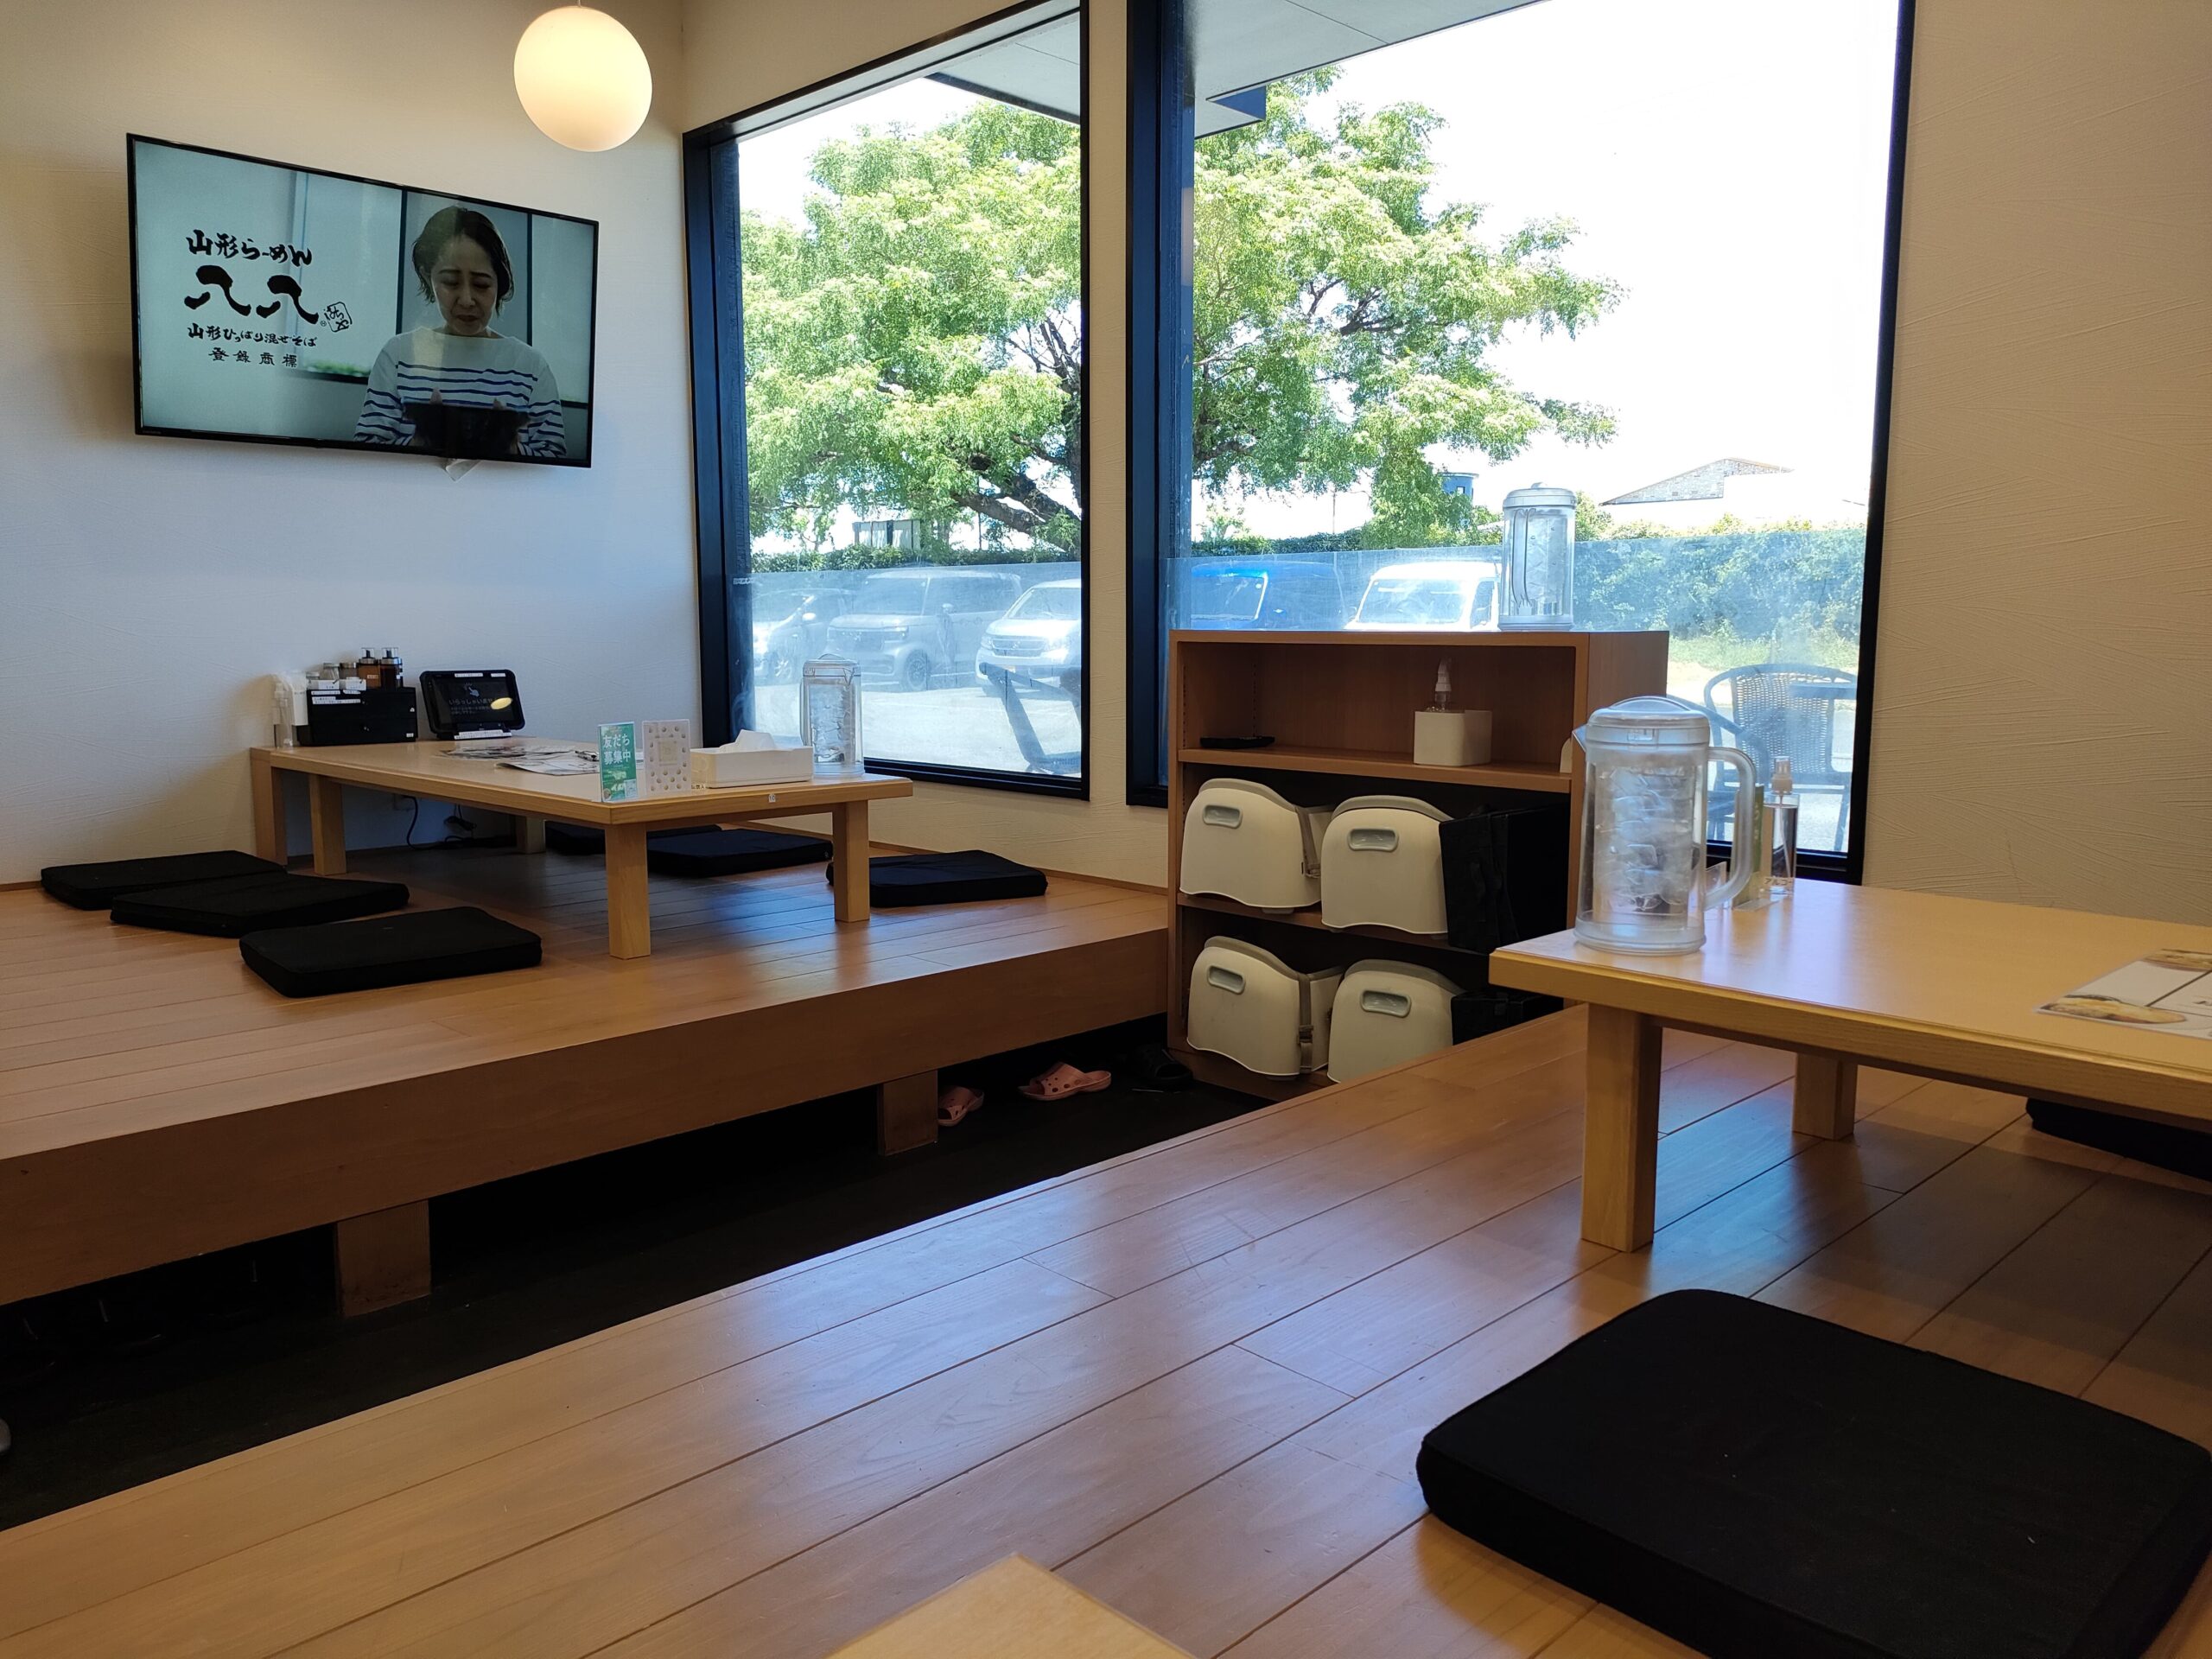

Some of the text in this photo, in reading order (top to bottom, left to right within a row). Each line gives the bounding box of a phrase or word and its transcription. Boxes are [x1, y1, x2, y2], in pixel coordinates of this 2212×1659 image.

[186, 229, 312, 267] 山形らーめん
[184, 264, 319, 325] 八八
[208, 347, 297, 368] 登録商標
[603, 733, 631, 748] 友だち
[603, 749, 632, 766] 募集中
